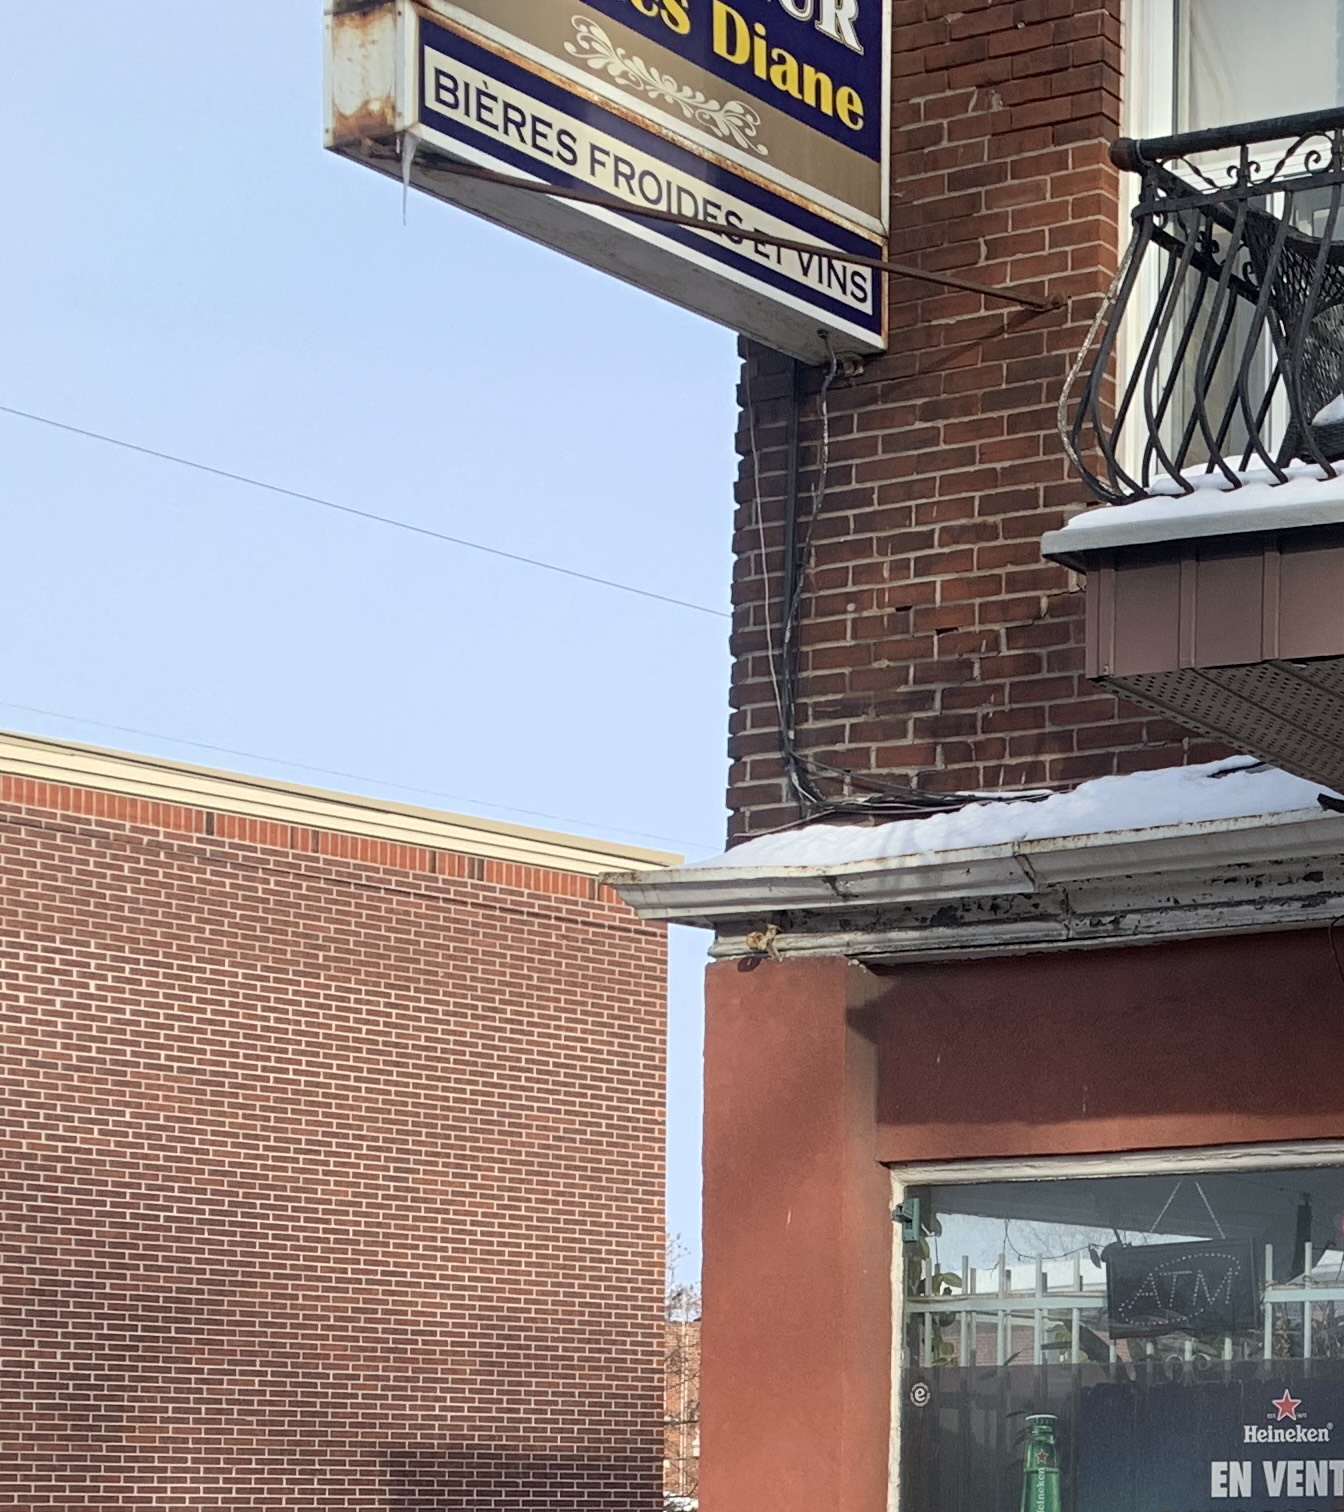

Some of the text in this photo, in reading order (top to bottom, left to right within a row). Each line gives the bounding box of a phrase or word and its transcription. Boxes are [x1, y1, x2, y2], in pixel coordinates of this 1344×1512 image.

[712, 0, 864, 131] Diane
[434, 66, 578, 166] BIÈRES
[589, 142, 743, 245] FROIDES
[797, 250, 868, 304] VINS
[1128, 1266, 1233, 1308] ATM
[1243, 1423, 1331, 1444] Heineken
[1211, 1461, 1252, 1498] EN
